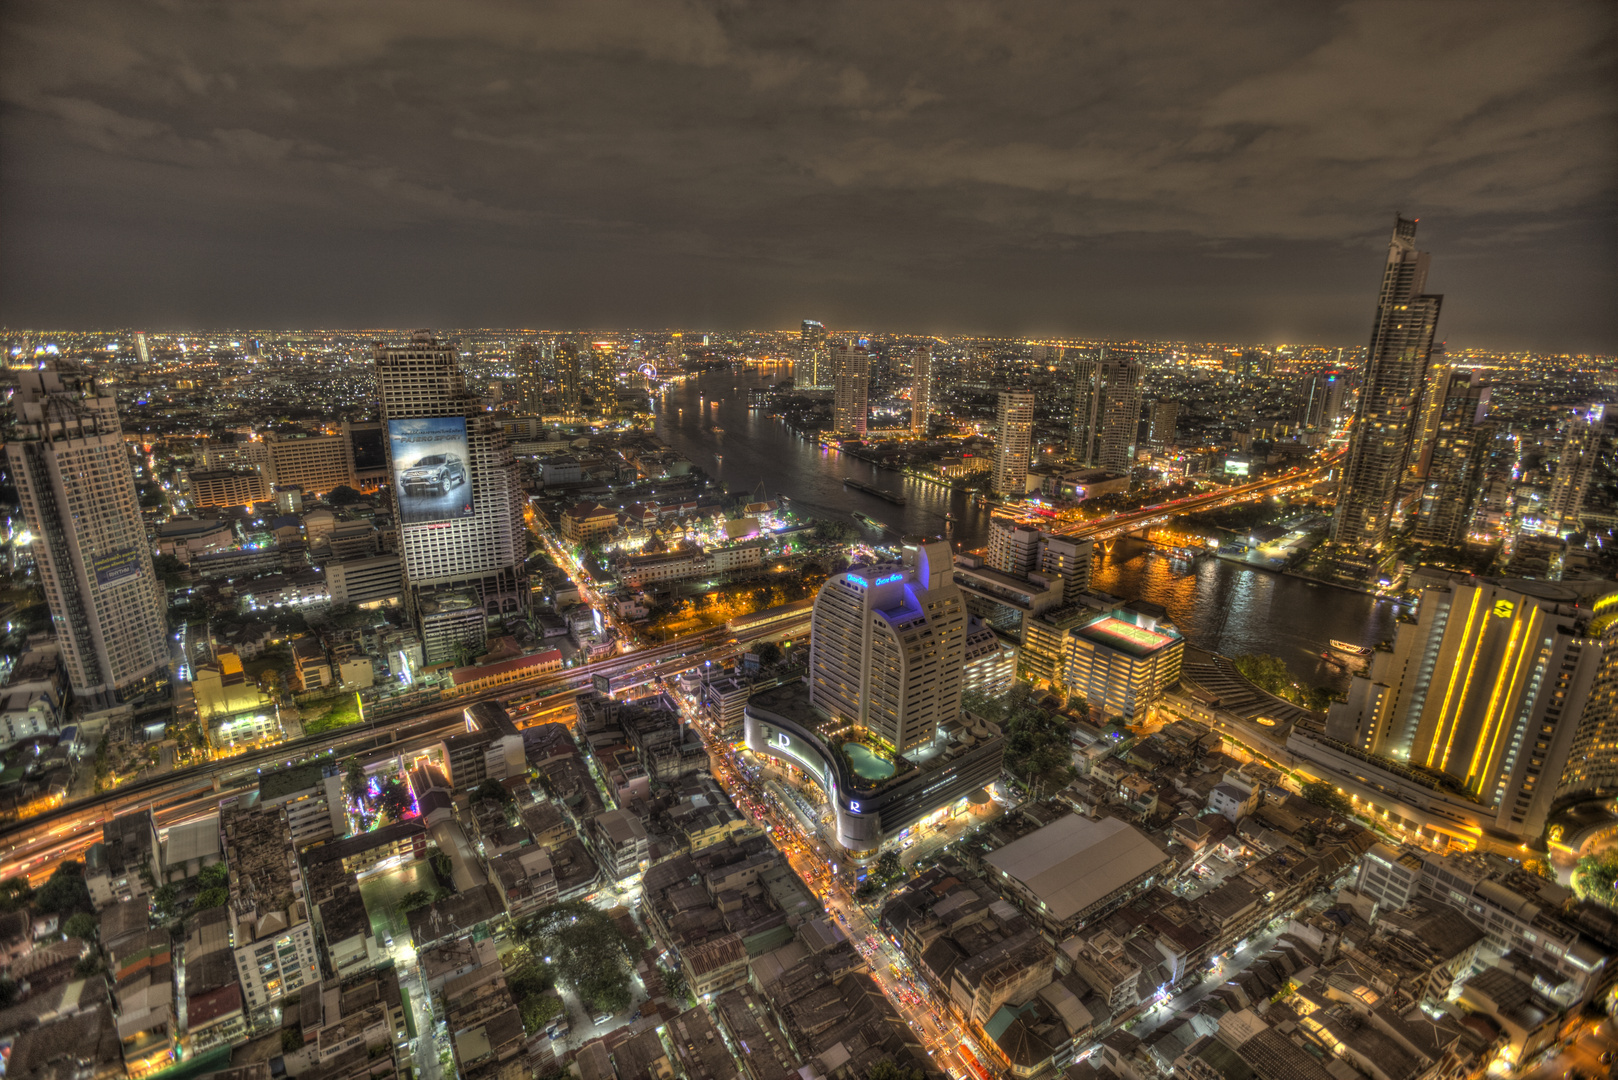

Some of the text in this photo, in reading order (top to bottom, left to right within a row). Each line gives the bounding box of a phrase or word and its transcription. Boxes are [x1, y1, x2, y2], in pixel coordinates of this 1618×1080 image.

[400, 434, 463, 443] PAJERO SPORT
[850, 800, 861, 813] R
